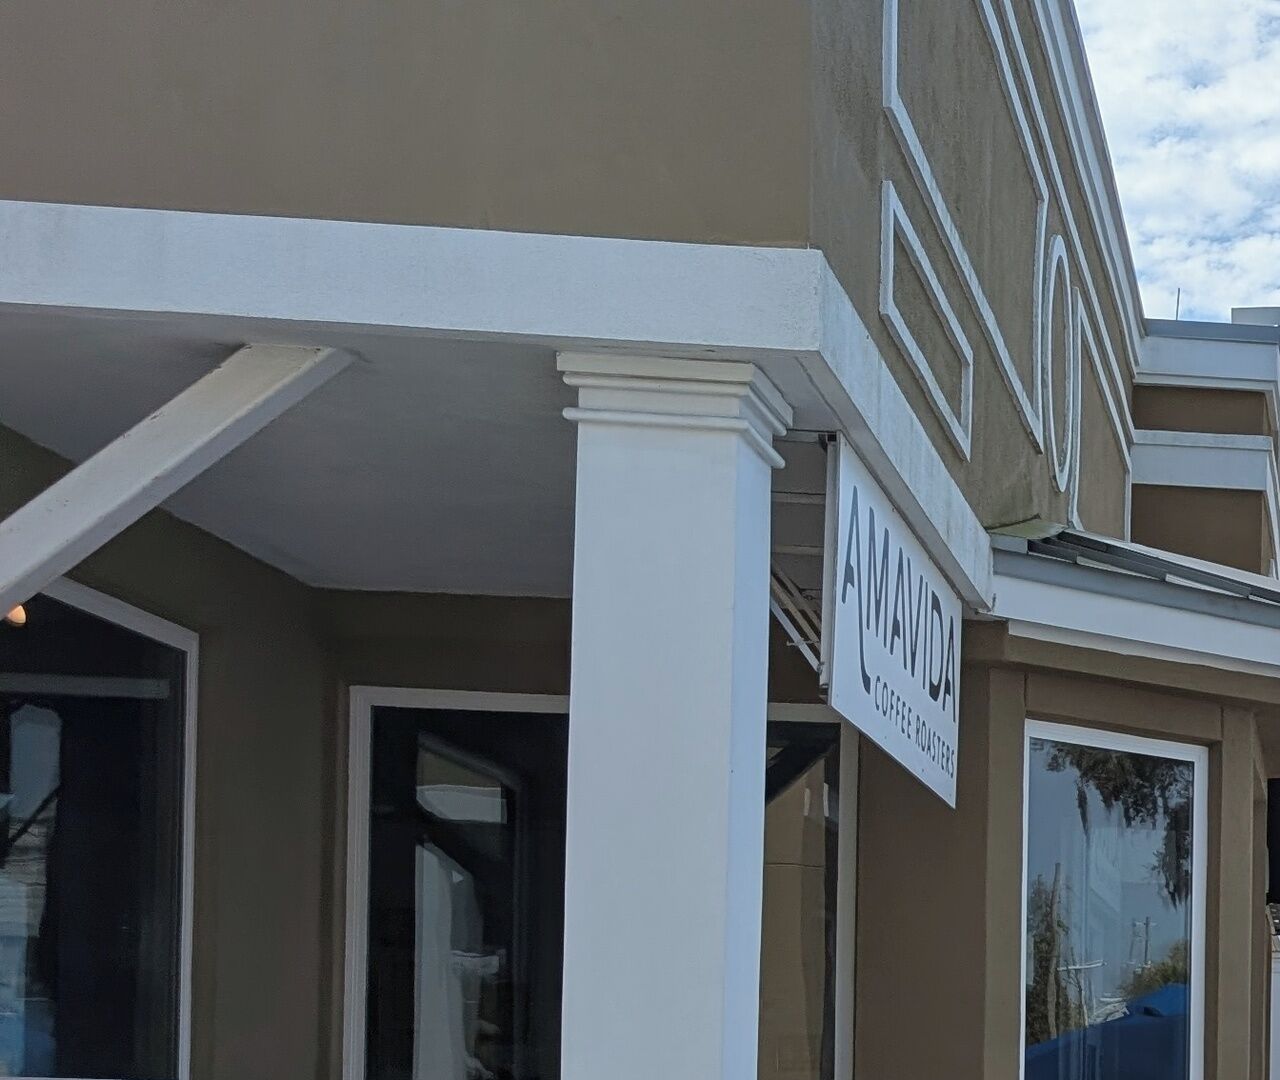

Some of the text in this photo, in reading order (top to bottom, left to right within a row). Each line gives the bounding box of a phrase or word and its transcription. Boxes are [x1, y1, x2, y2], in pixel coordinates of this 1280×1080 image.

[842, 485, 957, 723] AMAVIDA
[873, 674, 955, 779] COFFEE ROASTERS
